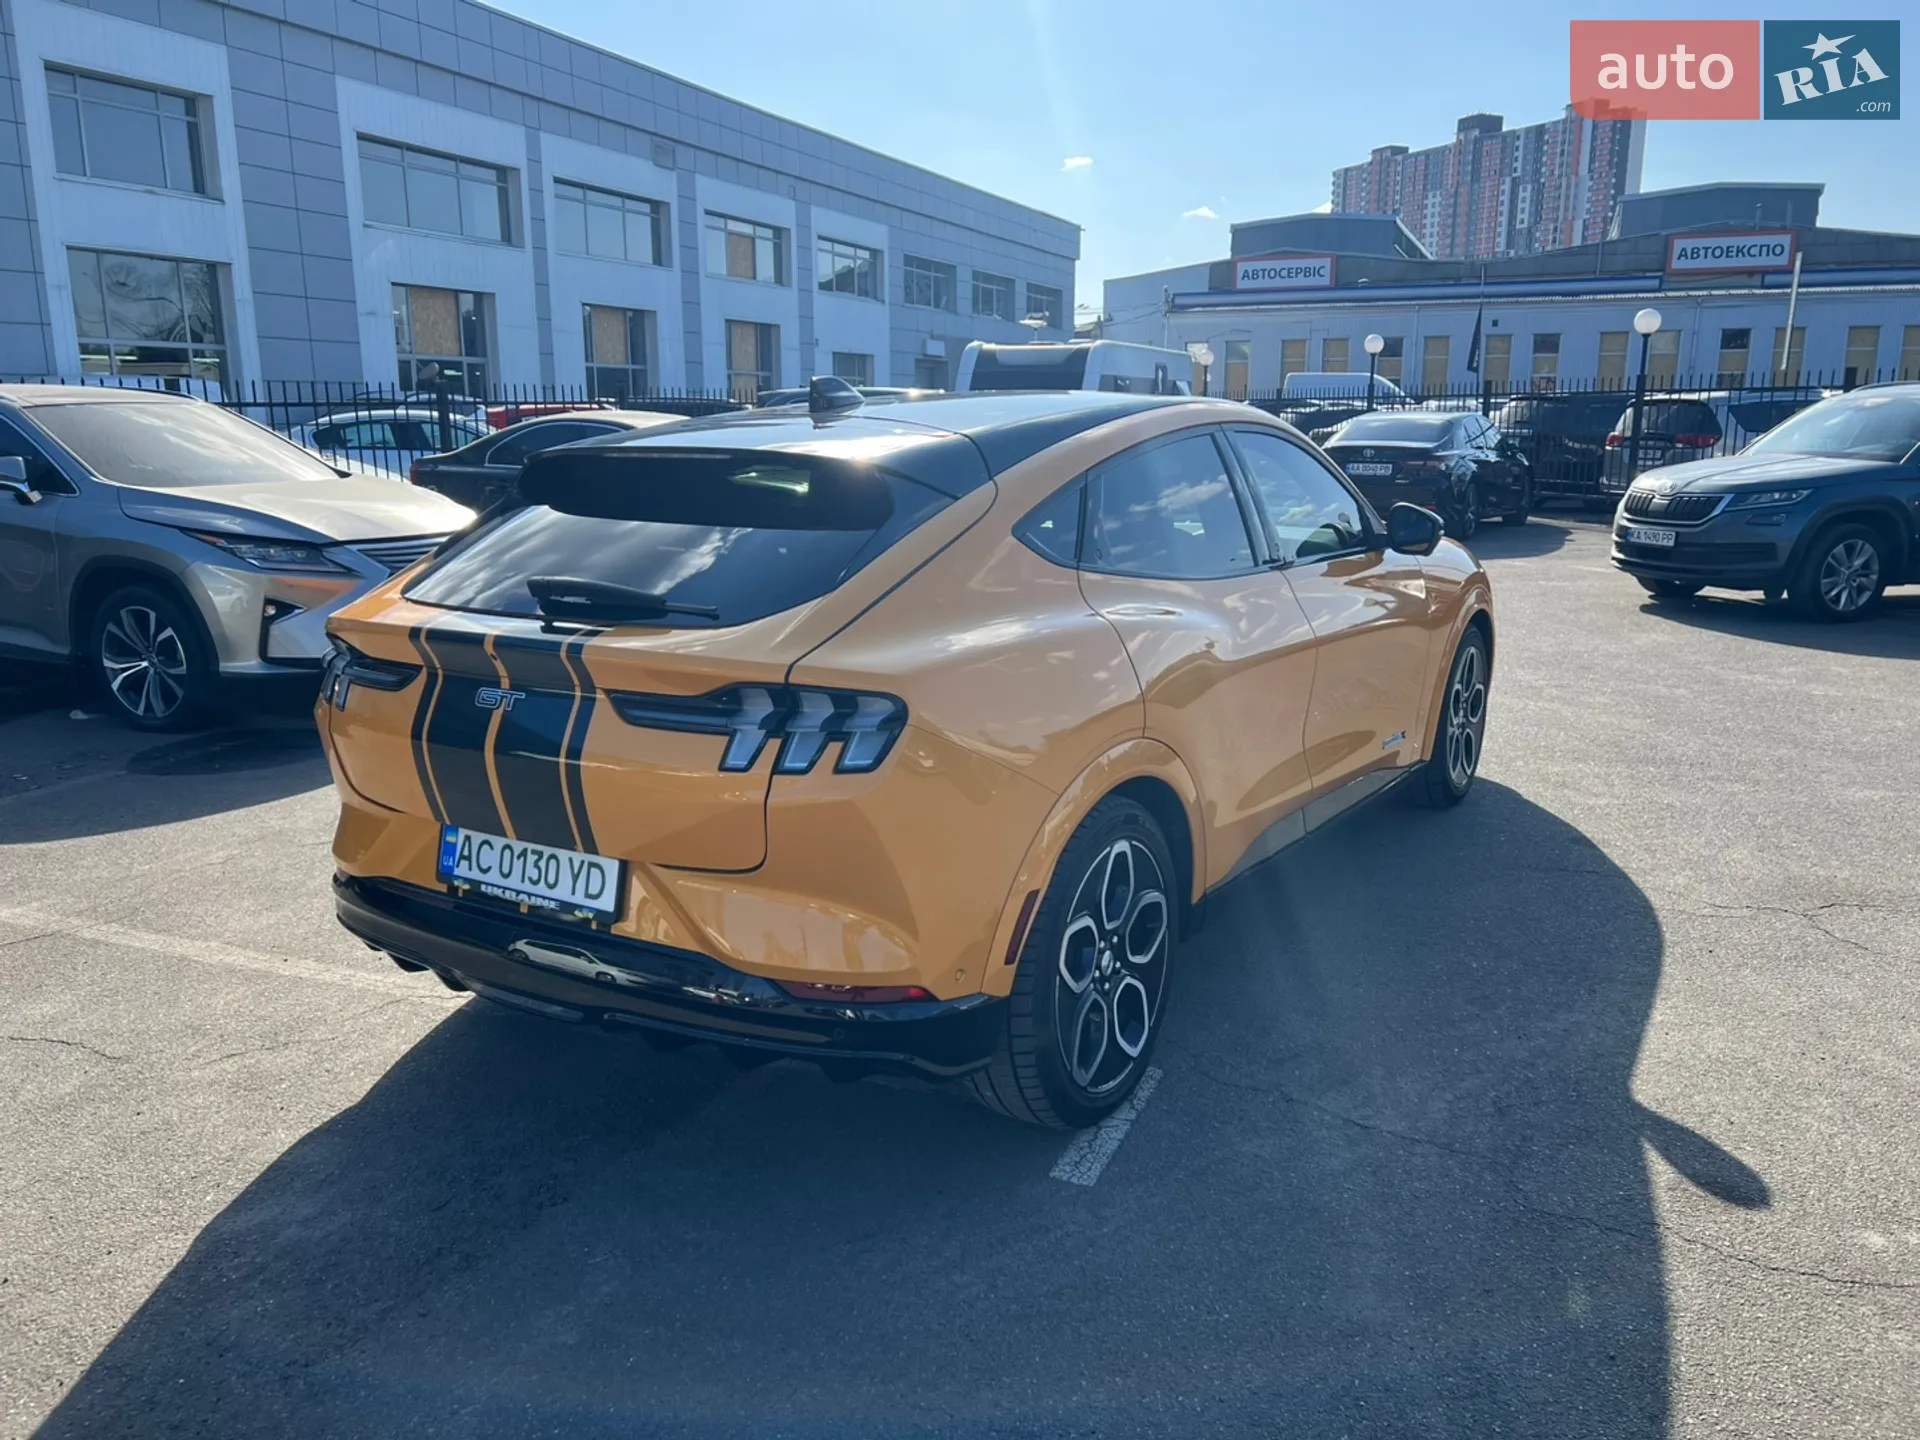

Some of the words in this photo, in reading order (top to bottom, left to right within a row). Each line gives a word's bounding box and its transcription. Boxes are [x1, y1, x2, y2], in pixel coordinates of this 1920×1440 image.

[1677, 243, 1785, 260] АВТОЕКСПО
[1241, 265, 1326, 281] АВТОСЕРВІС
[475, 687, 526, 711] GT
[442, 854, 454, 868] UA
[456, 834, 494, 875] AC
[498, 843, 561, 890] 0130
[568, 856, 606, 900] YD
